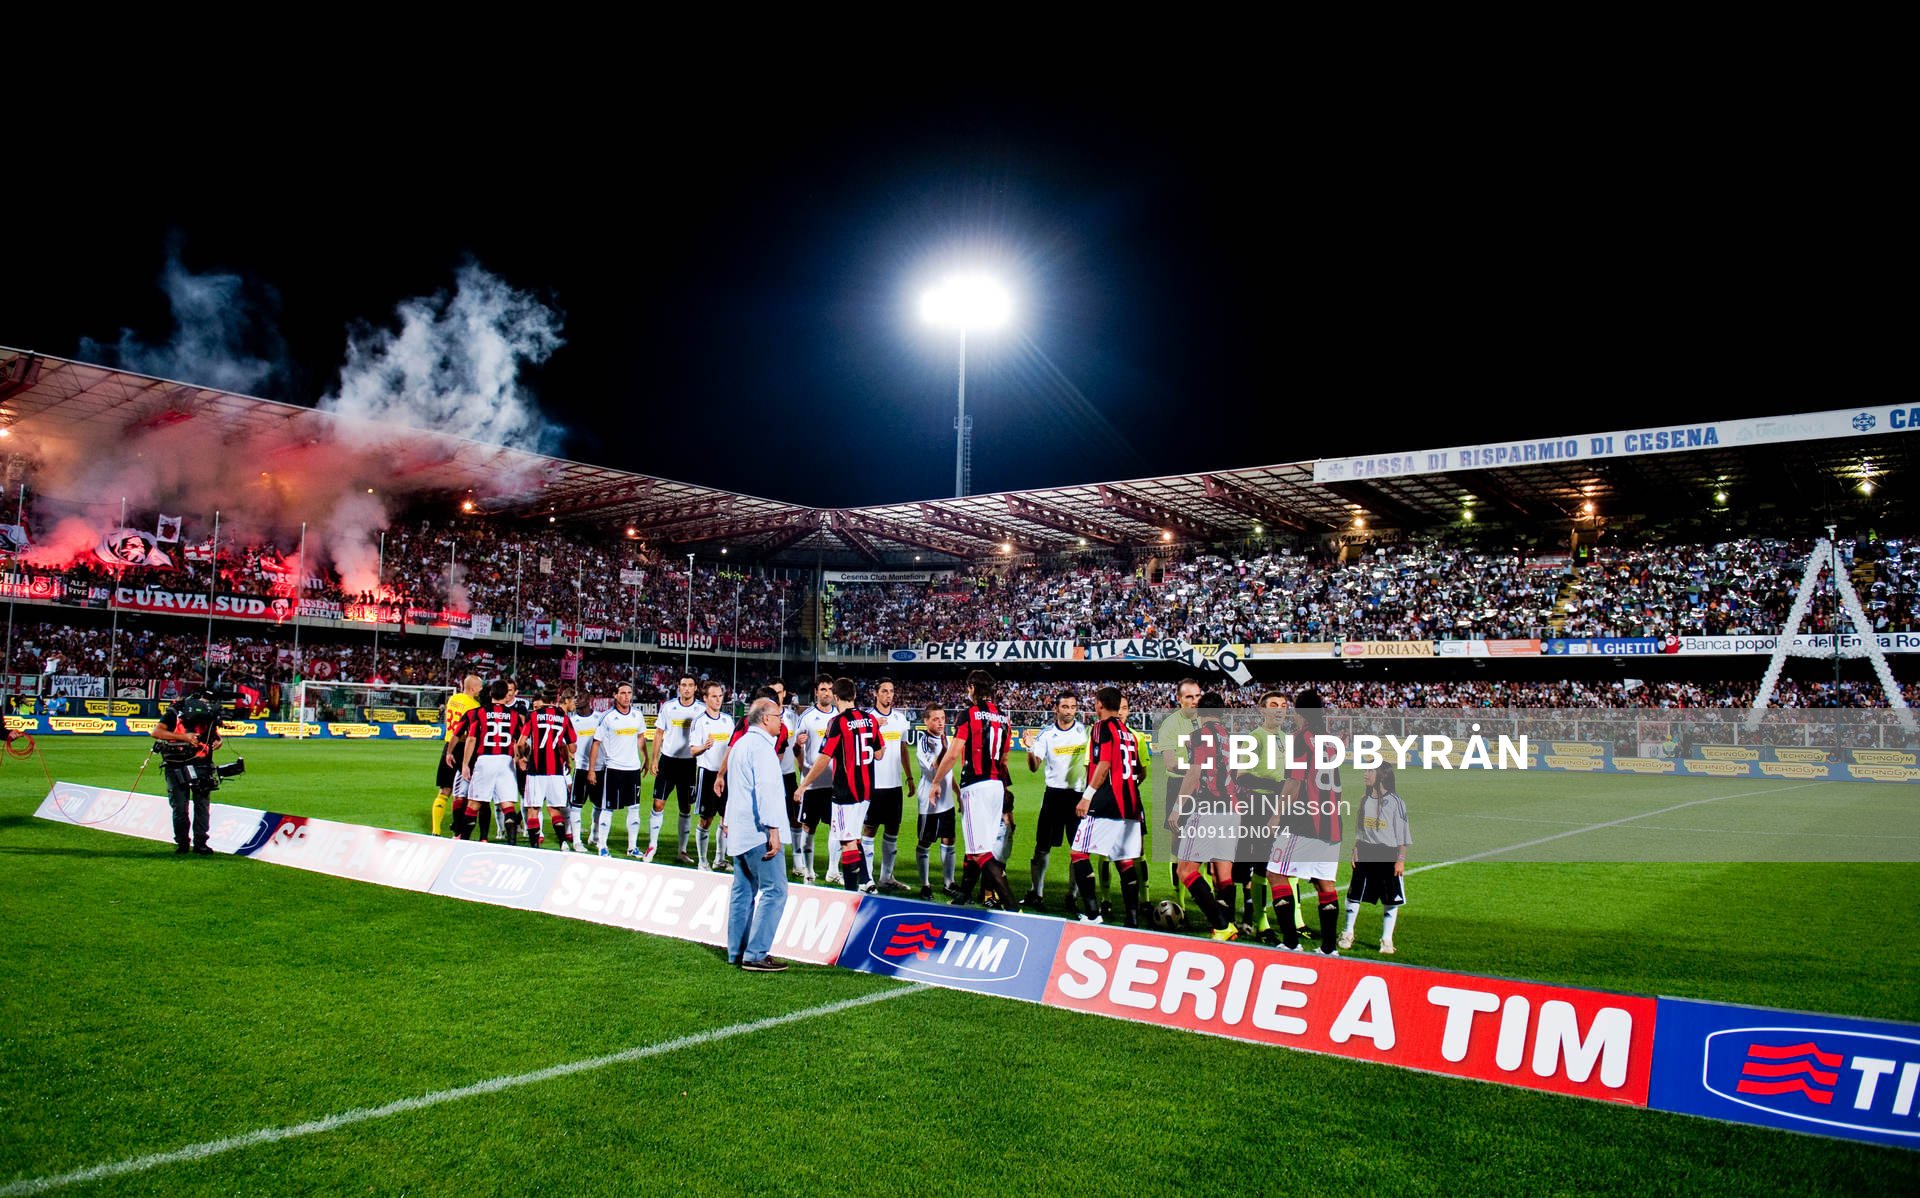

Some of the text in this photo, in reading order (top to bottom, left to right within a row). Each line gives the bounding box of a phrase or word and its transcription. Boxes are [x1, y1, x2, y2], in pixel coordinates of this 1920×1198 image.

[1352, 426, 1719, 477] CASSA DI RISPARMIO DI CESENA
[841, 573, 868, 581] Cesena
[870, 572, 886, 581] Club
[115, 587, 266, 615] CURVA SUD
[299, 599, 340, 611] ASSENTI
[294, 606, 344, 620] PRESENTI
[660, 633, 713, 649] BELLUSCO
[1093, 640, 1116, 658] TI
[1367, 643, 1432, 656] LORIANA
[1604, 642, 1655, 654] GHETTI
[1686, 638, 1732, 650] Banca
[1735, 637, 1804, 652] popole
[926, 642, 967, 660] PER
[975, 641, 999, 660] 19
[1003, 641, 1066, 660] ANNI
[486, 711, 511, 721] BONERA
[483, 721, 512, 747] 25
[537, 723, 564, 750] 77
[856, 732, 874, 767] 15
[989, 726, 1004, 761] 11
[1778, 751, 1826, 761] TECHNOGY
[1857, 753, 1914, 763] TECHNOGYM
[1689, 762, 1747, 772] TECHNOGYM
[1764, 765, 1826, 775] TECHNOGYM
[1853, 767, 1919, 777] TECHNOGYM
[488, 862, 847, 954] TIM SERIE A IM
[936, 931, 1633, 1089] TIM SERIE A TIM
[1851, 1056, 1920, 1118] TI
